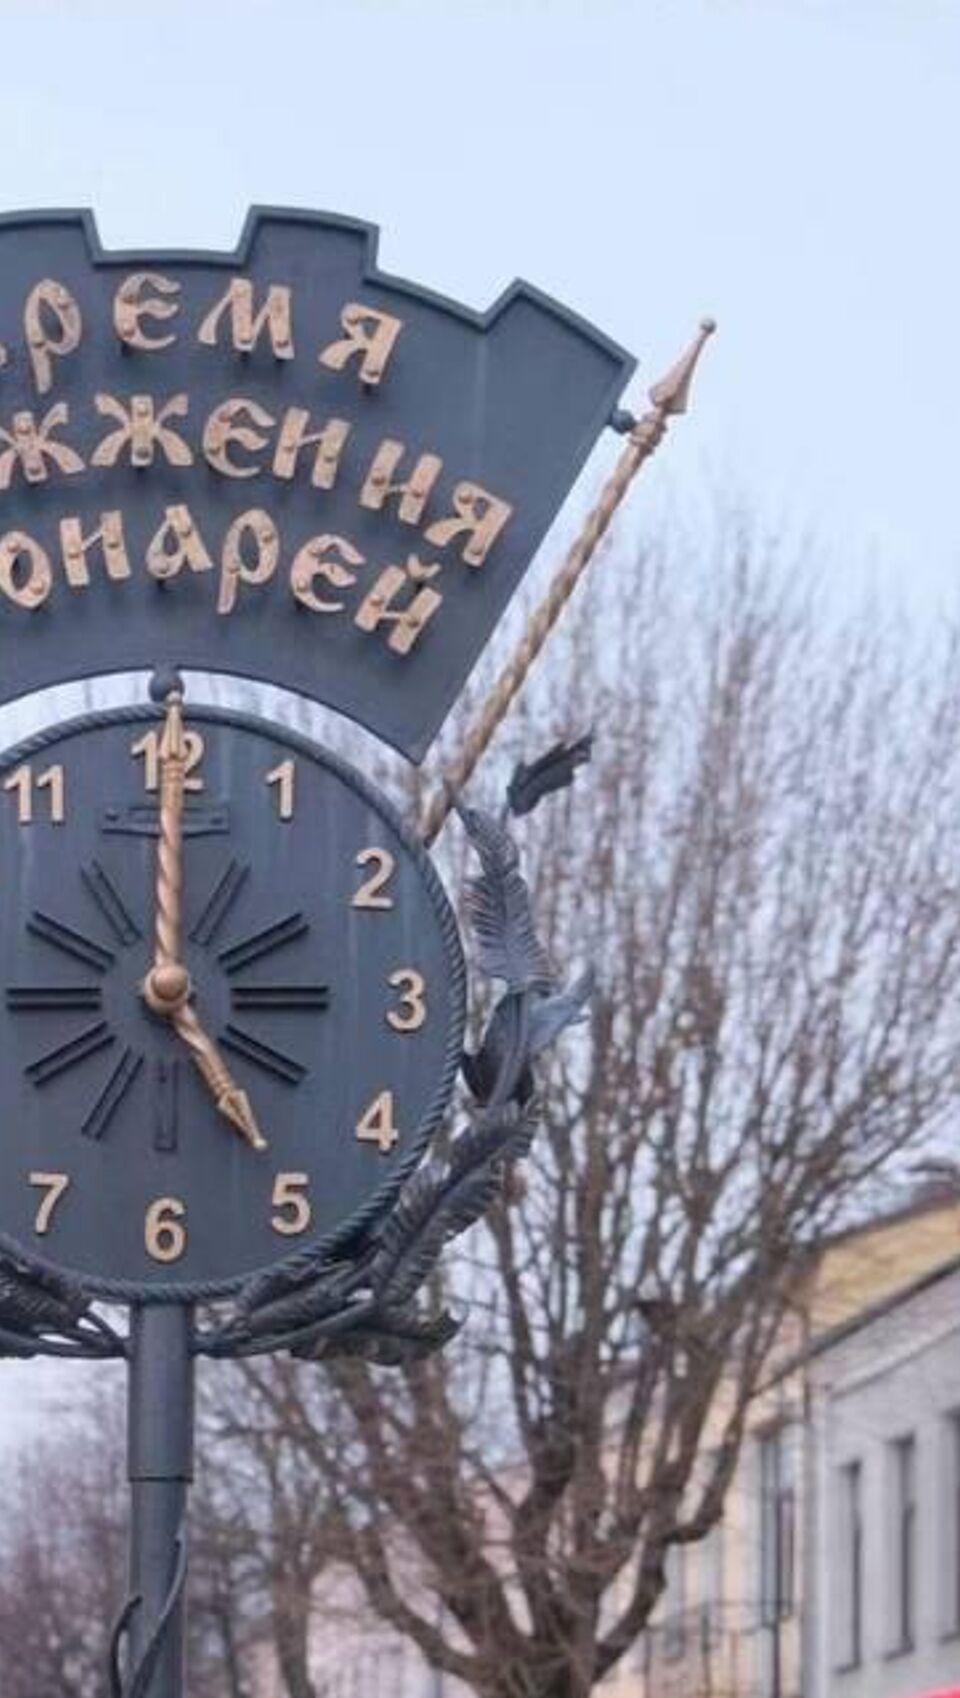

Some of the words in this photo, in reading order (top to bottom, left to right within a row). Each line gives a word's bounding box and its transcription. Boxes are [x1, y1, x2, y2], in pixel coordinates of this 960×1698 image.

[4, 765, 66, 824] 11
[267, 760, 295, 820] 1
[353, 848, 396, 909] 2
[386, 969, 427, 1032] 3
[356, 1091, 399, 1152] 4
[29, 1172, 69, 1235] 7
[145, 1199, 186, 1262] 6
[271, 1173, 310, 1236] 5
